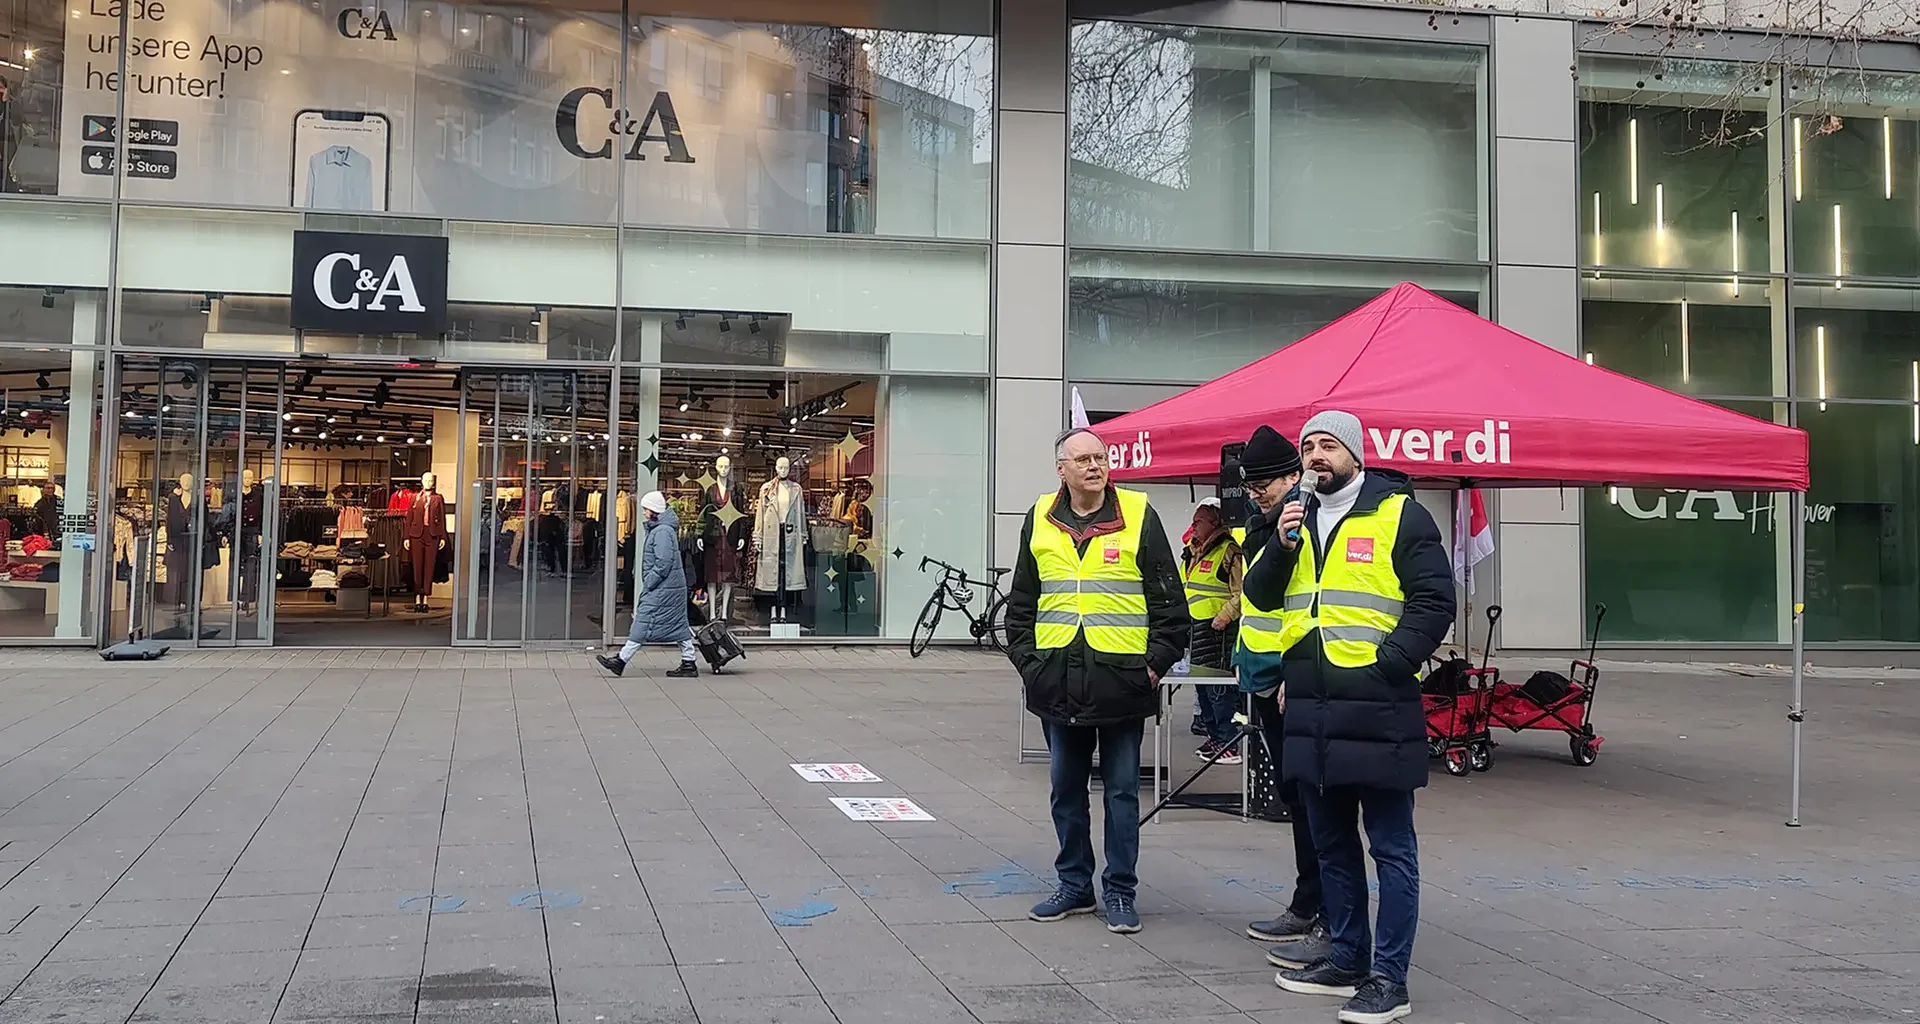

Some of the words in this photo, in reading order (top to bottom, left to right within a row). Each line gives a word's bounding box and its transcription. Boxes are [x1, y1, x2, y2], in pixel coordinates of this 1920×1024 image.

[337, 8, 398, 41] C&A
[200, 35, 263, 71] App
[86, 62, 225, 99] heunter!
[151, 130, 172, 143] Play
[555, 87, 696, 163] C&A
[137, 161, 170, 174] Store
[313, 252, 426, 313] C&A
[1107, 431, 1152, 470] er.di
[1368, 420, 1511, 464] ver.di
